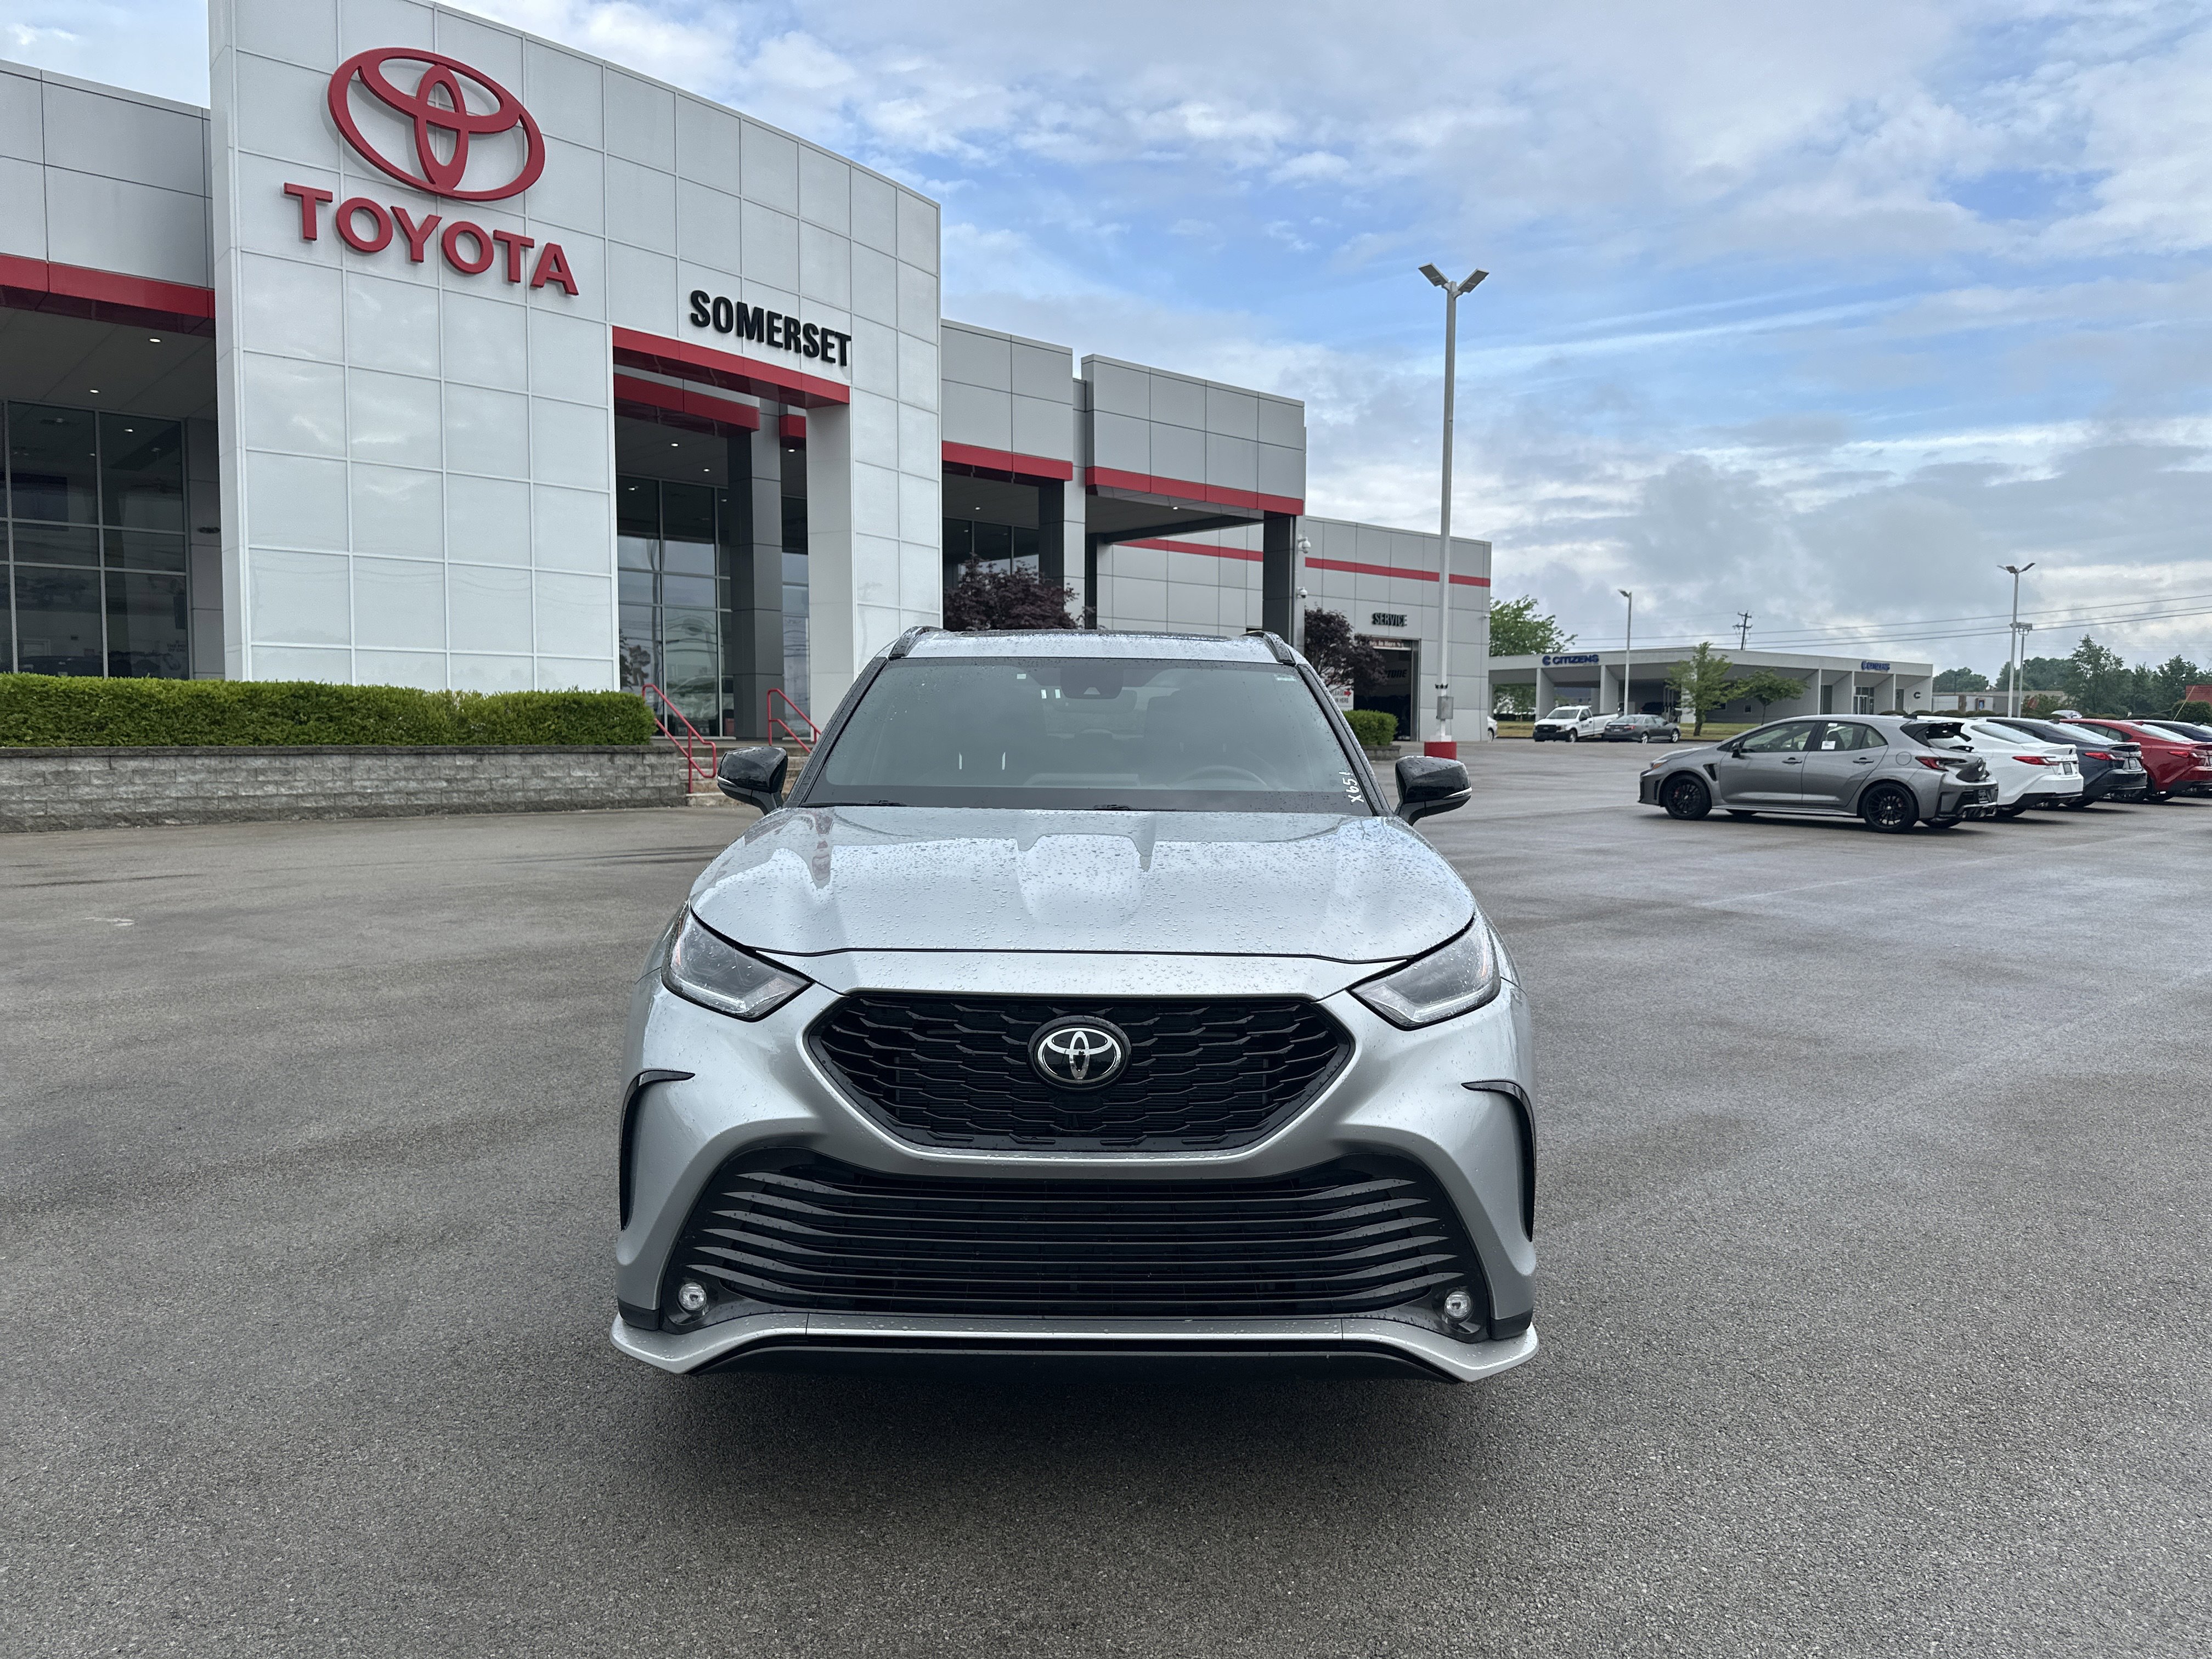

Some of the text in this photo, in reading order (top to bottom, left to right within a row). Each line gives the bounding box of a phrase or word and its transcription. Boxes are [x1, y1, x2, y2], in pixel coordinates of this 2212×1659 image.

[284, 182, 579, 296] TOYOTA
[690, 290, 852, 366] SOMERSET
[1372, 612, 1407, 627] SERVICE
[1553, 654, 1599, 664] CITIZENS
